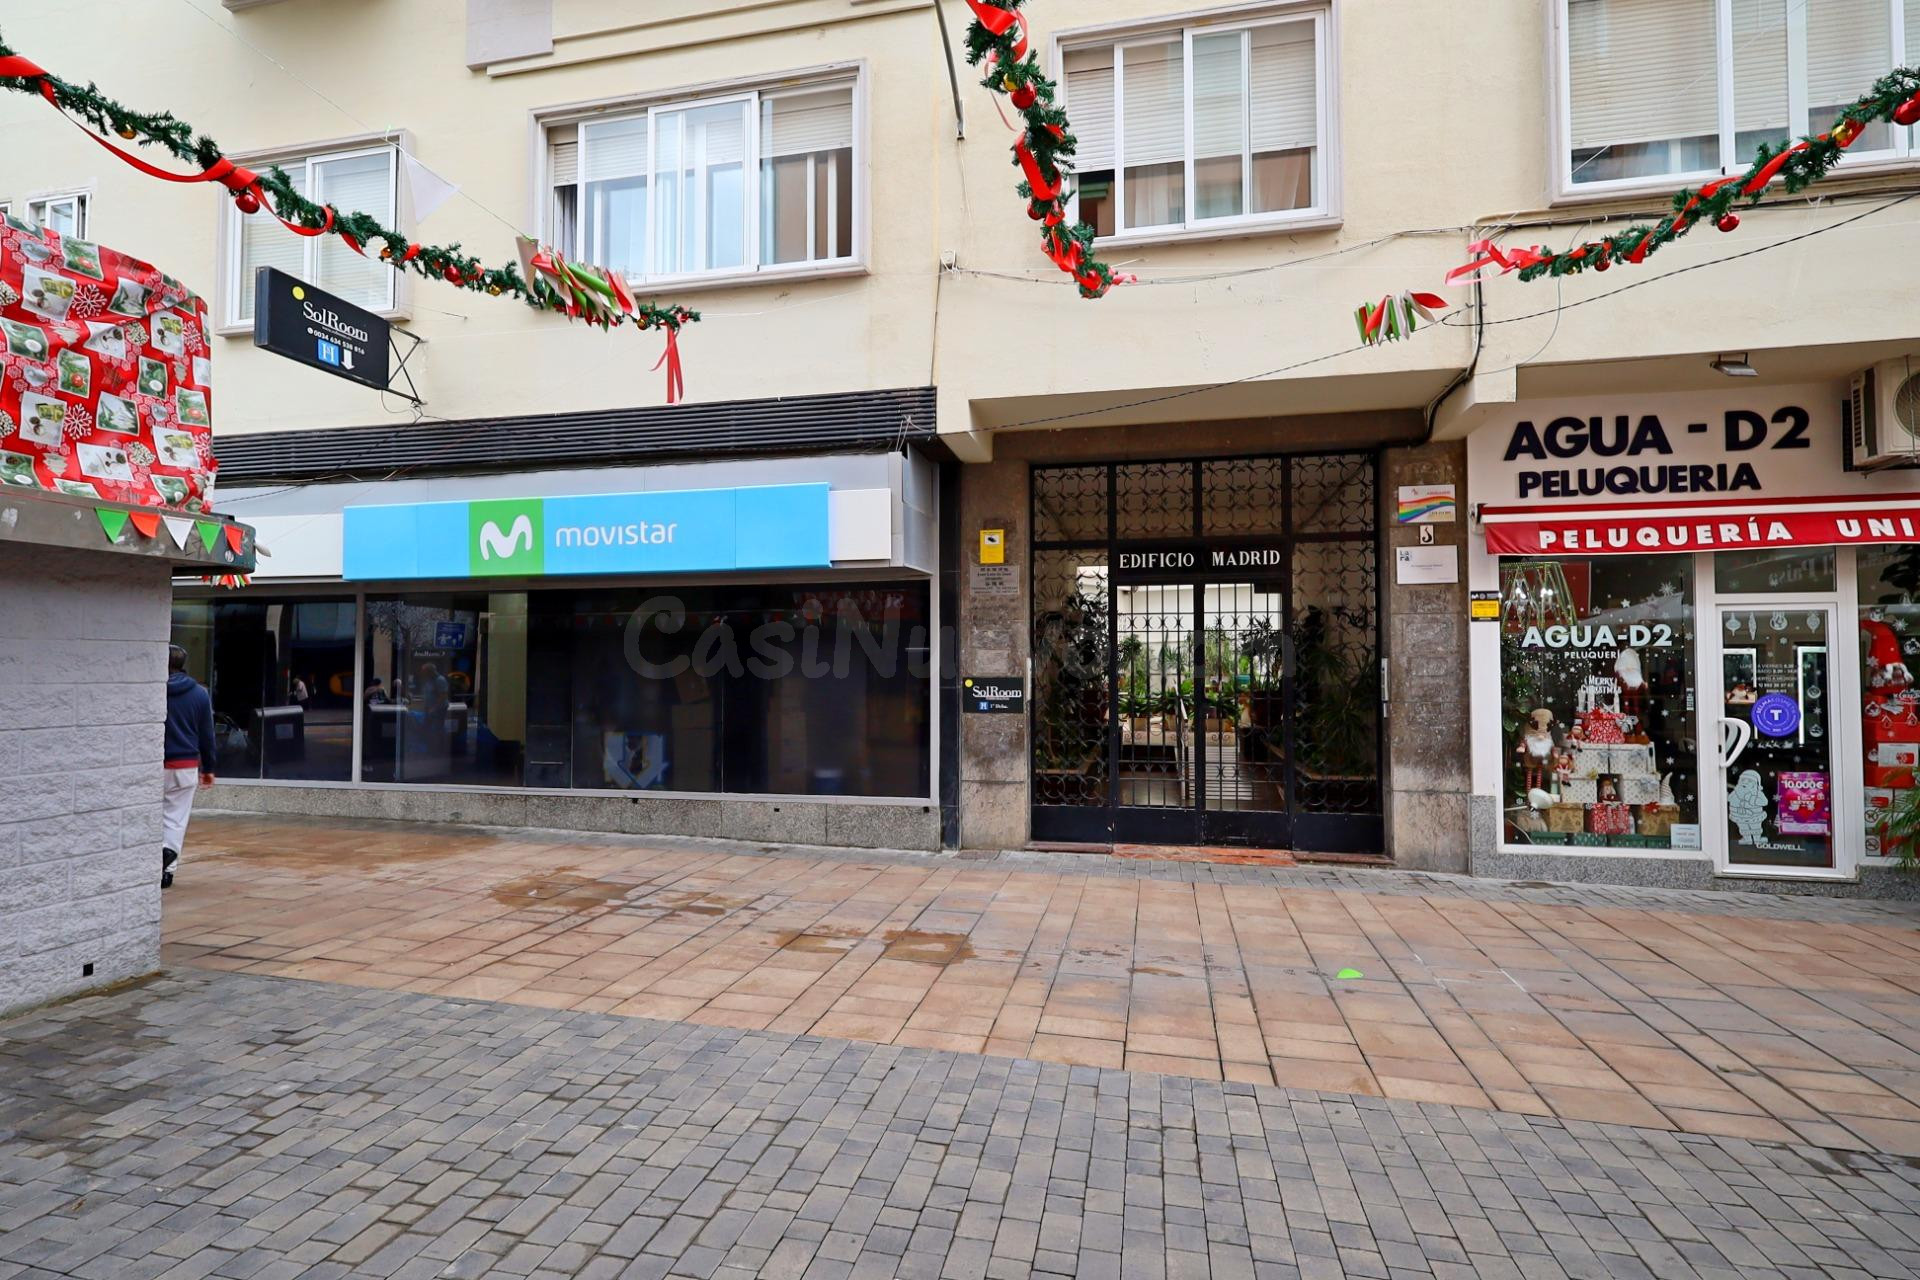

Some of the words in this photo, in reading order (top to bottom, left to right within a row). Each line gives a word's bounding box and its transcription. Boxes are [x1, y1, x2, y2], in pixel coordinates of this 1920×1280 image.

[303, 301, 368, 342] SolRoom
[1503, 415, 1673, 461] AGUA
[1725, 406, 1811, 451] D2
[1518, 463, 1762, 498] PELUQUERIA
[556, 521, 678, 548] movistar
[1539, 517, 1793, 549] PELUQUERÍA
[1119, 552, 1195, 568] EDIFICIO
[1212, 550, 1281, 566] MADRID
[1521, 624, 1673, 648] AGUA-D2
[972, 685, 1022, 698] SolRoom
